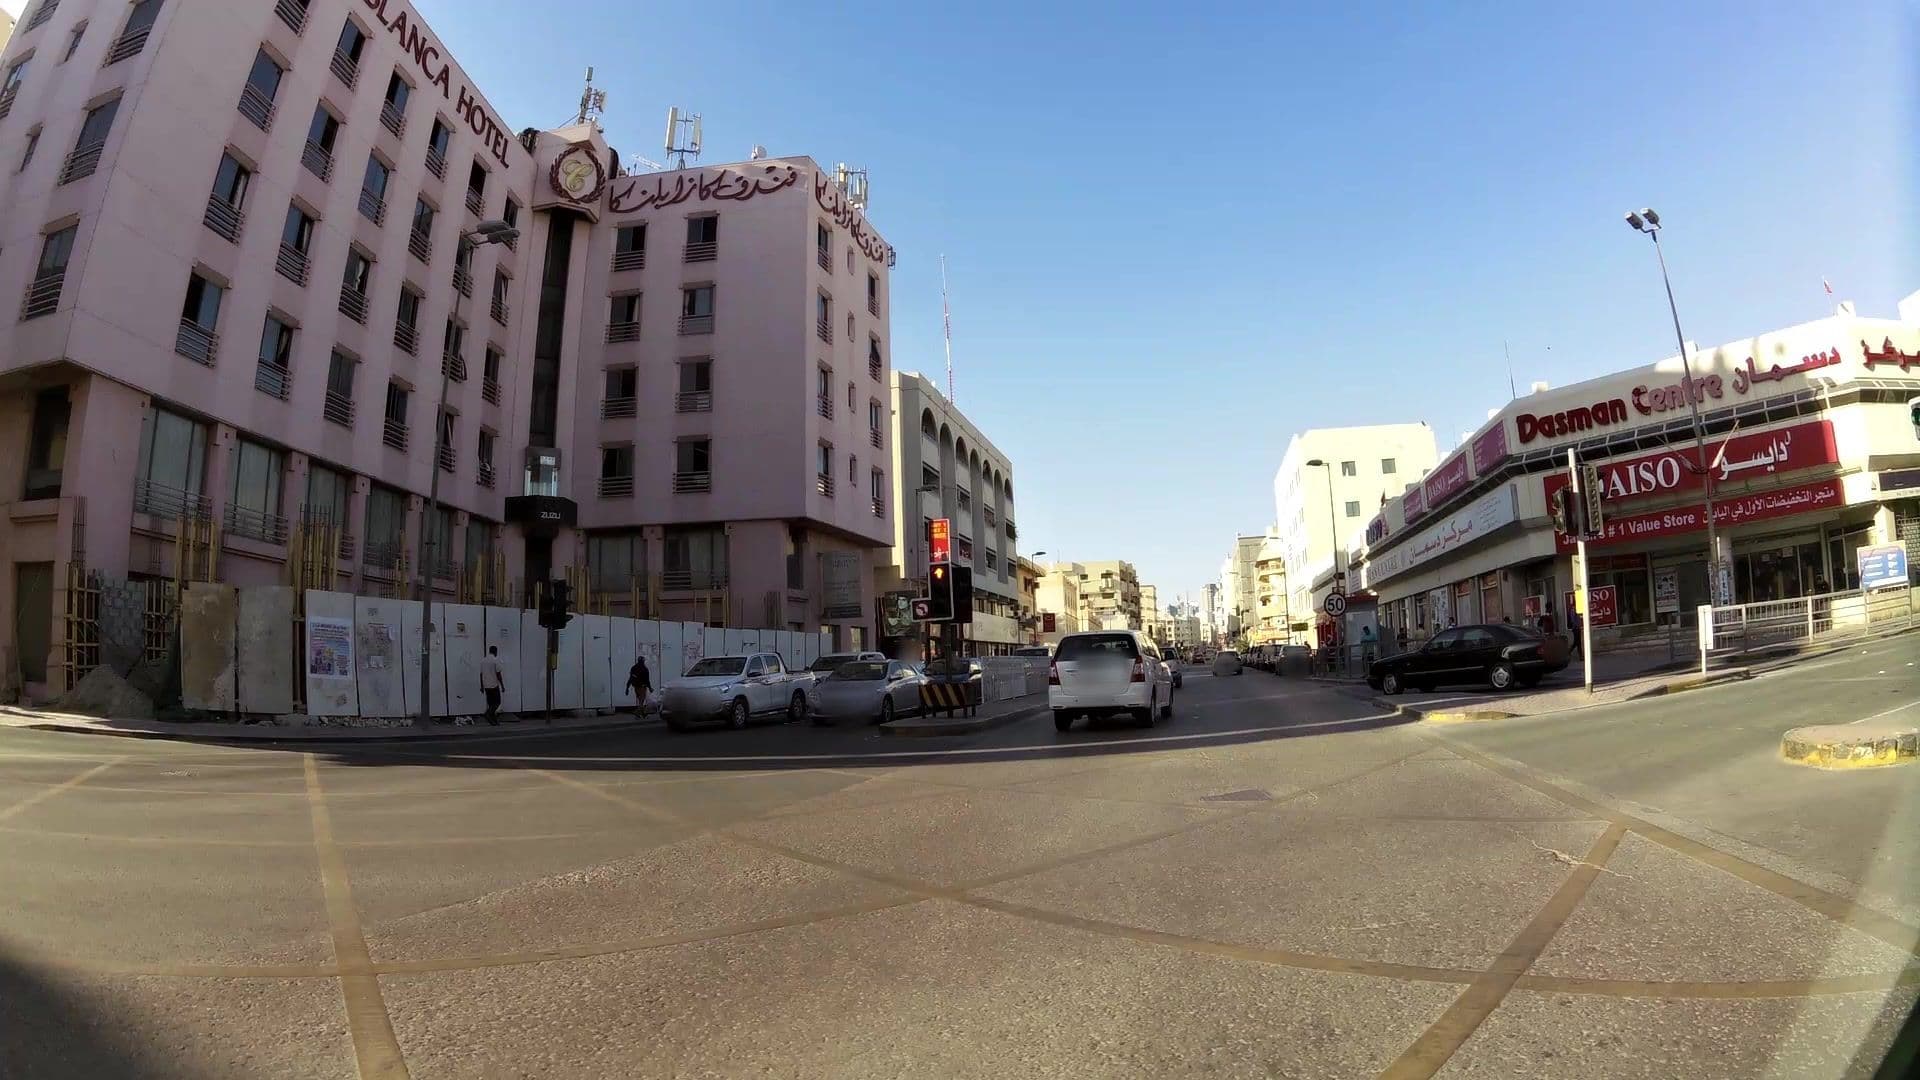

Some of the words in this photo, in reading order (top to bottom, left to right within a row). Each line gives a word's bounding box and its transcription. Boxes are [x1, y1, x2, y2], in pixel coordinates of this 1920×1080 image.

[455, 84, 510, 169] HOTEL
[712, 165, 798, 201] فندق
[1860, 335, 1920, 374] ركز
[1732, 345, 1841, 395] دسمان
[1515, 397, 1628, 444] Dasman
[1599, 456, 1680, 499] AISO
[1744, 496, 1766, 515] الأول
[1765, 489, 1812, 509] التخفيضات
[1812, 486, 1835, 504] متجر
[1702, 505, 1731, 524] اليابن
[1730, 502, 1744, 521] في
[1607, 524, 1616, 538] #
[1619, 523, 1625, 536] 1
[1628, 519, 1661, 534] Value
[1663, 513, 1695, 528] Store
[1327, 598, 1344, 612] 50
